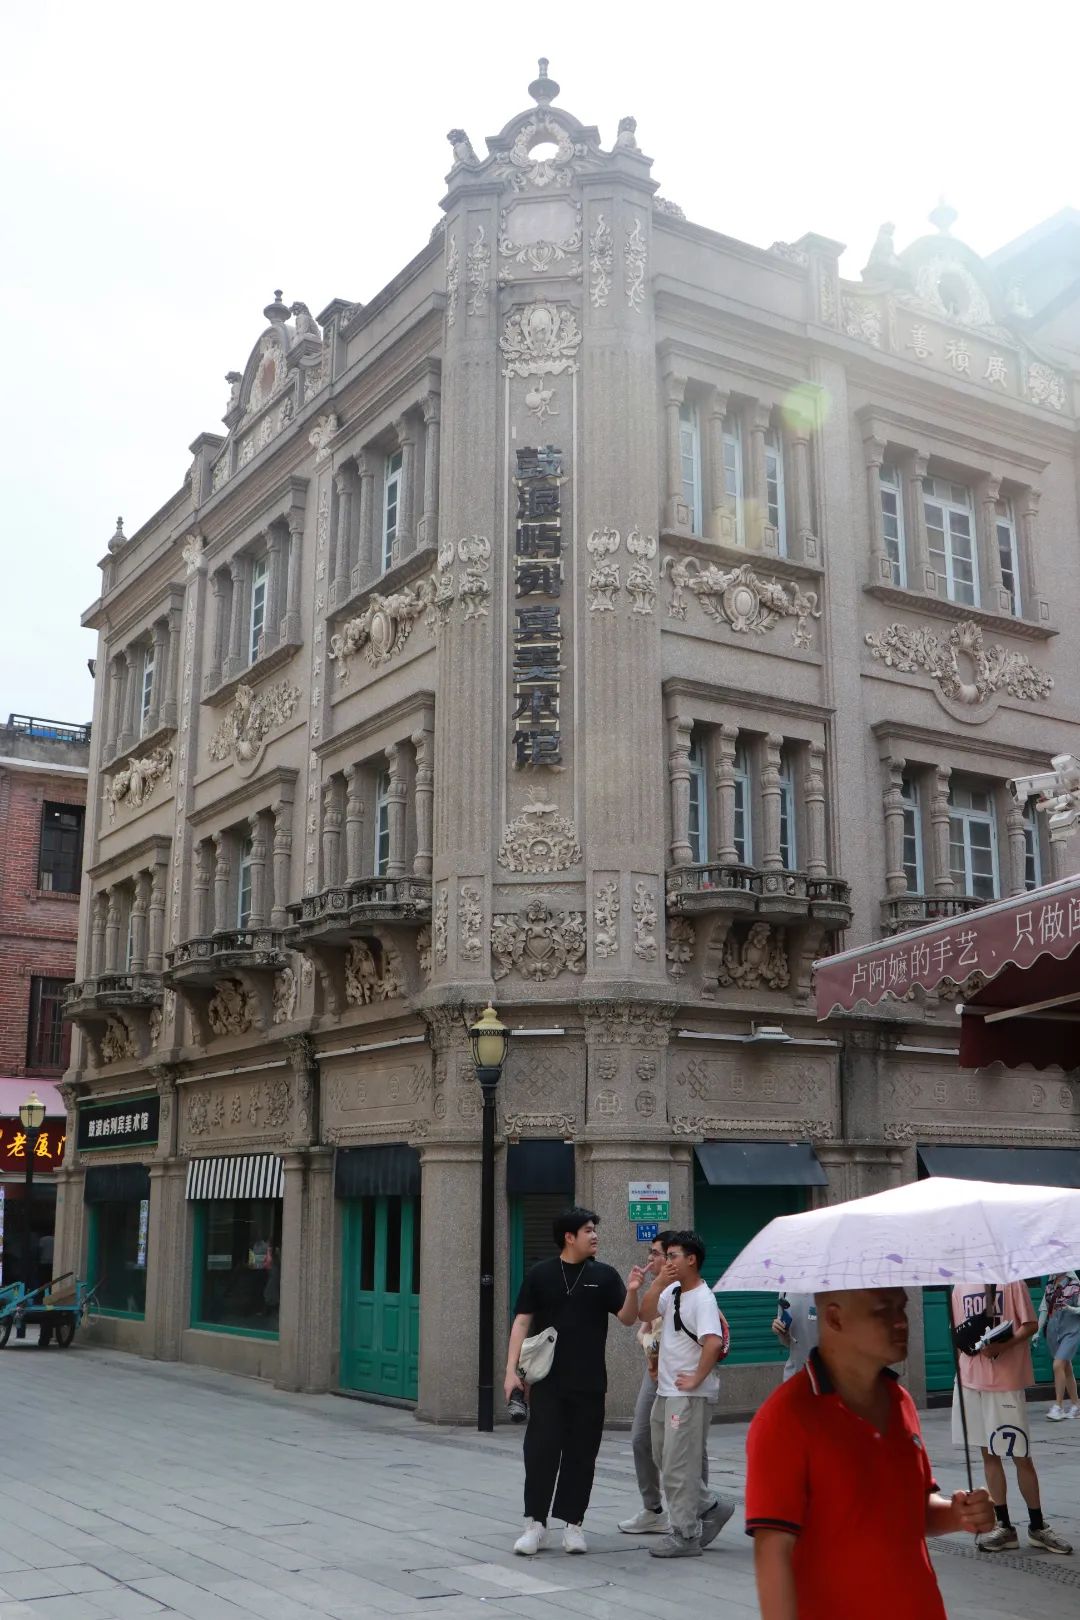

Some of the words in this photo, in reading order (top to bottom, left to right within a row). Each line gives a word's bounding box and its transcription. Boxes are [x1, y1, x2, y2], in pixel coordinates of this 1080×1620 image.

[88, 1111, 150, 1137] 鼓浪屿列宾美术馆
[964, 1292, 1001, 1317] ROK
[1002, 1432, 1017, 1457] 7
